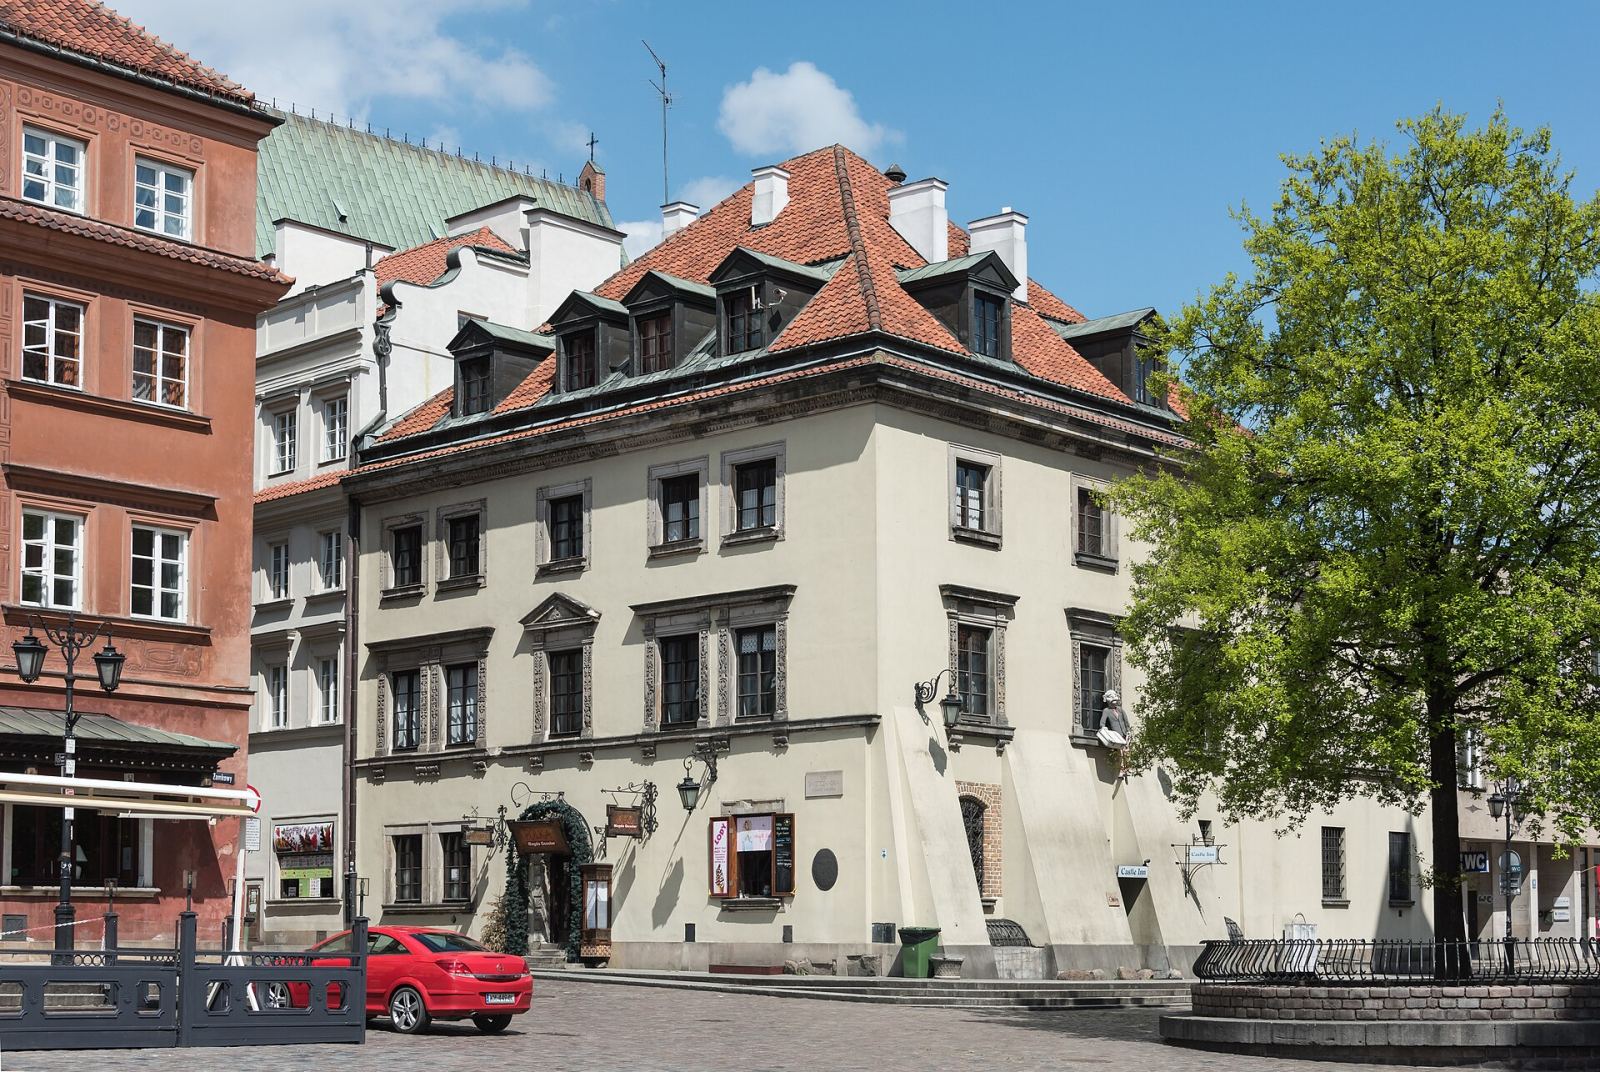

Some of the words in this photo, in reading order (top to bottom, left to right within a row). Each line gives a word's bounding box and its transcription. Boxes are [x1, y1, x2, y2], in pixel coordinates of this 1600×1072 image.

[1464, 853, 1486, 870] WC
[1120, 867, 1137, 876] Castle
[1137, 868, 1147, 876] Inn
